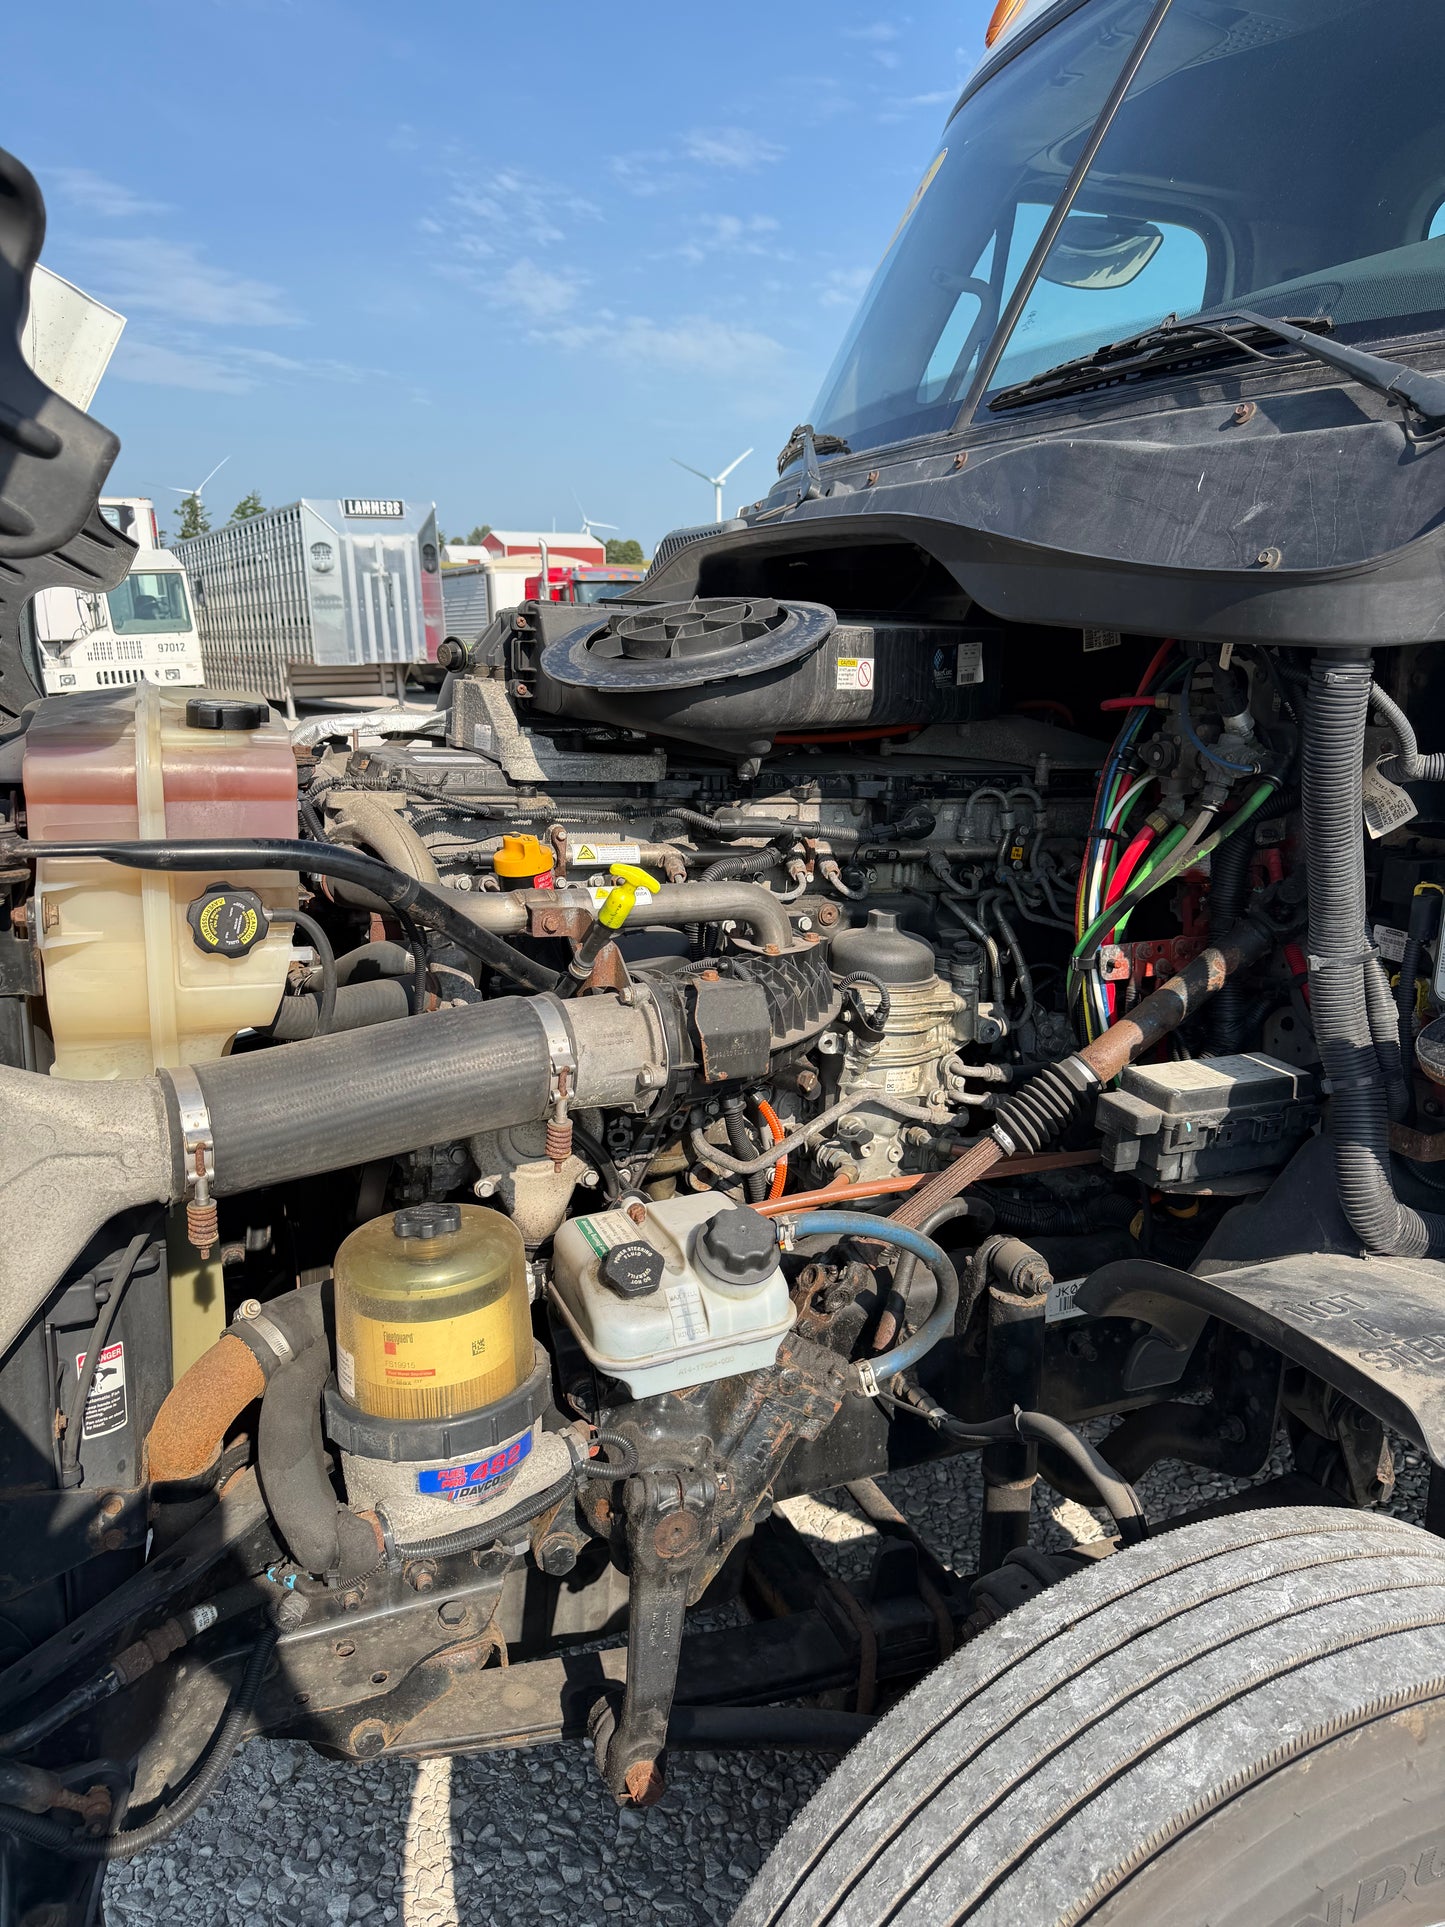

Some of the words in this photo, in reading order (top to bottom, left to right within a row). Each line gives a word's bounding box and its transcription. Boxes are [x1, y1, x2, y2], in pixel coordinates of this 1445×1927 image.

[157, 642, 186, 653] 97012
[201, 900, 219, 943] AVERTISSEMENT
[242, 916, 256, 943] CAUTION
[623, 1251, 642, 1260] FLUID
[627, 1246, 653, 1257] STEERING
[627, 1268, 652, 1280] OVERFILL
[1284, 1293, 1368, 1322] NOT
[1352, 1317, 1396, 1339] A
[470, 1443, 521, 1481] 482
[437, 1467, 468, 1481] FUEL
[441, 1477, 467, 1490] PRO
[459, 1478, 501, 1498] DAVCO
